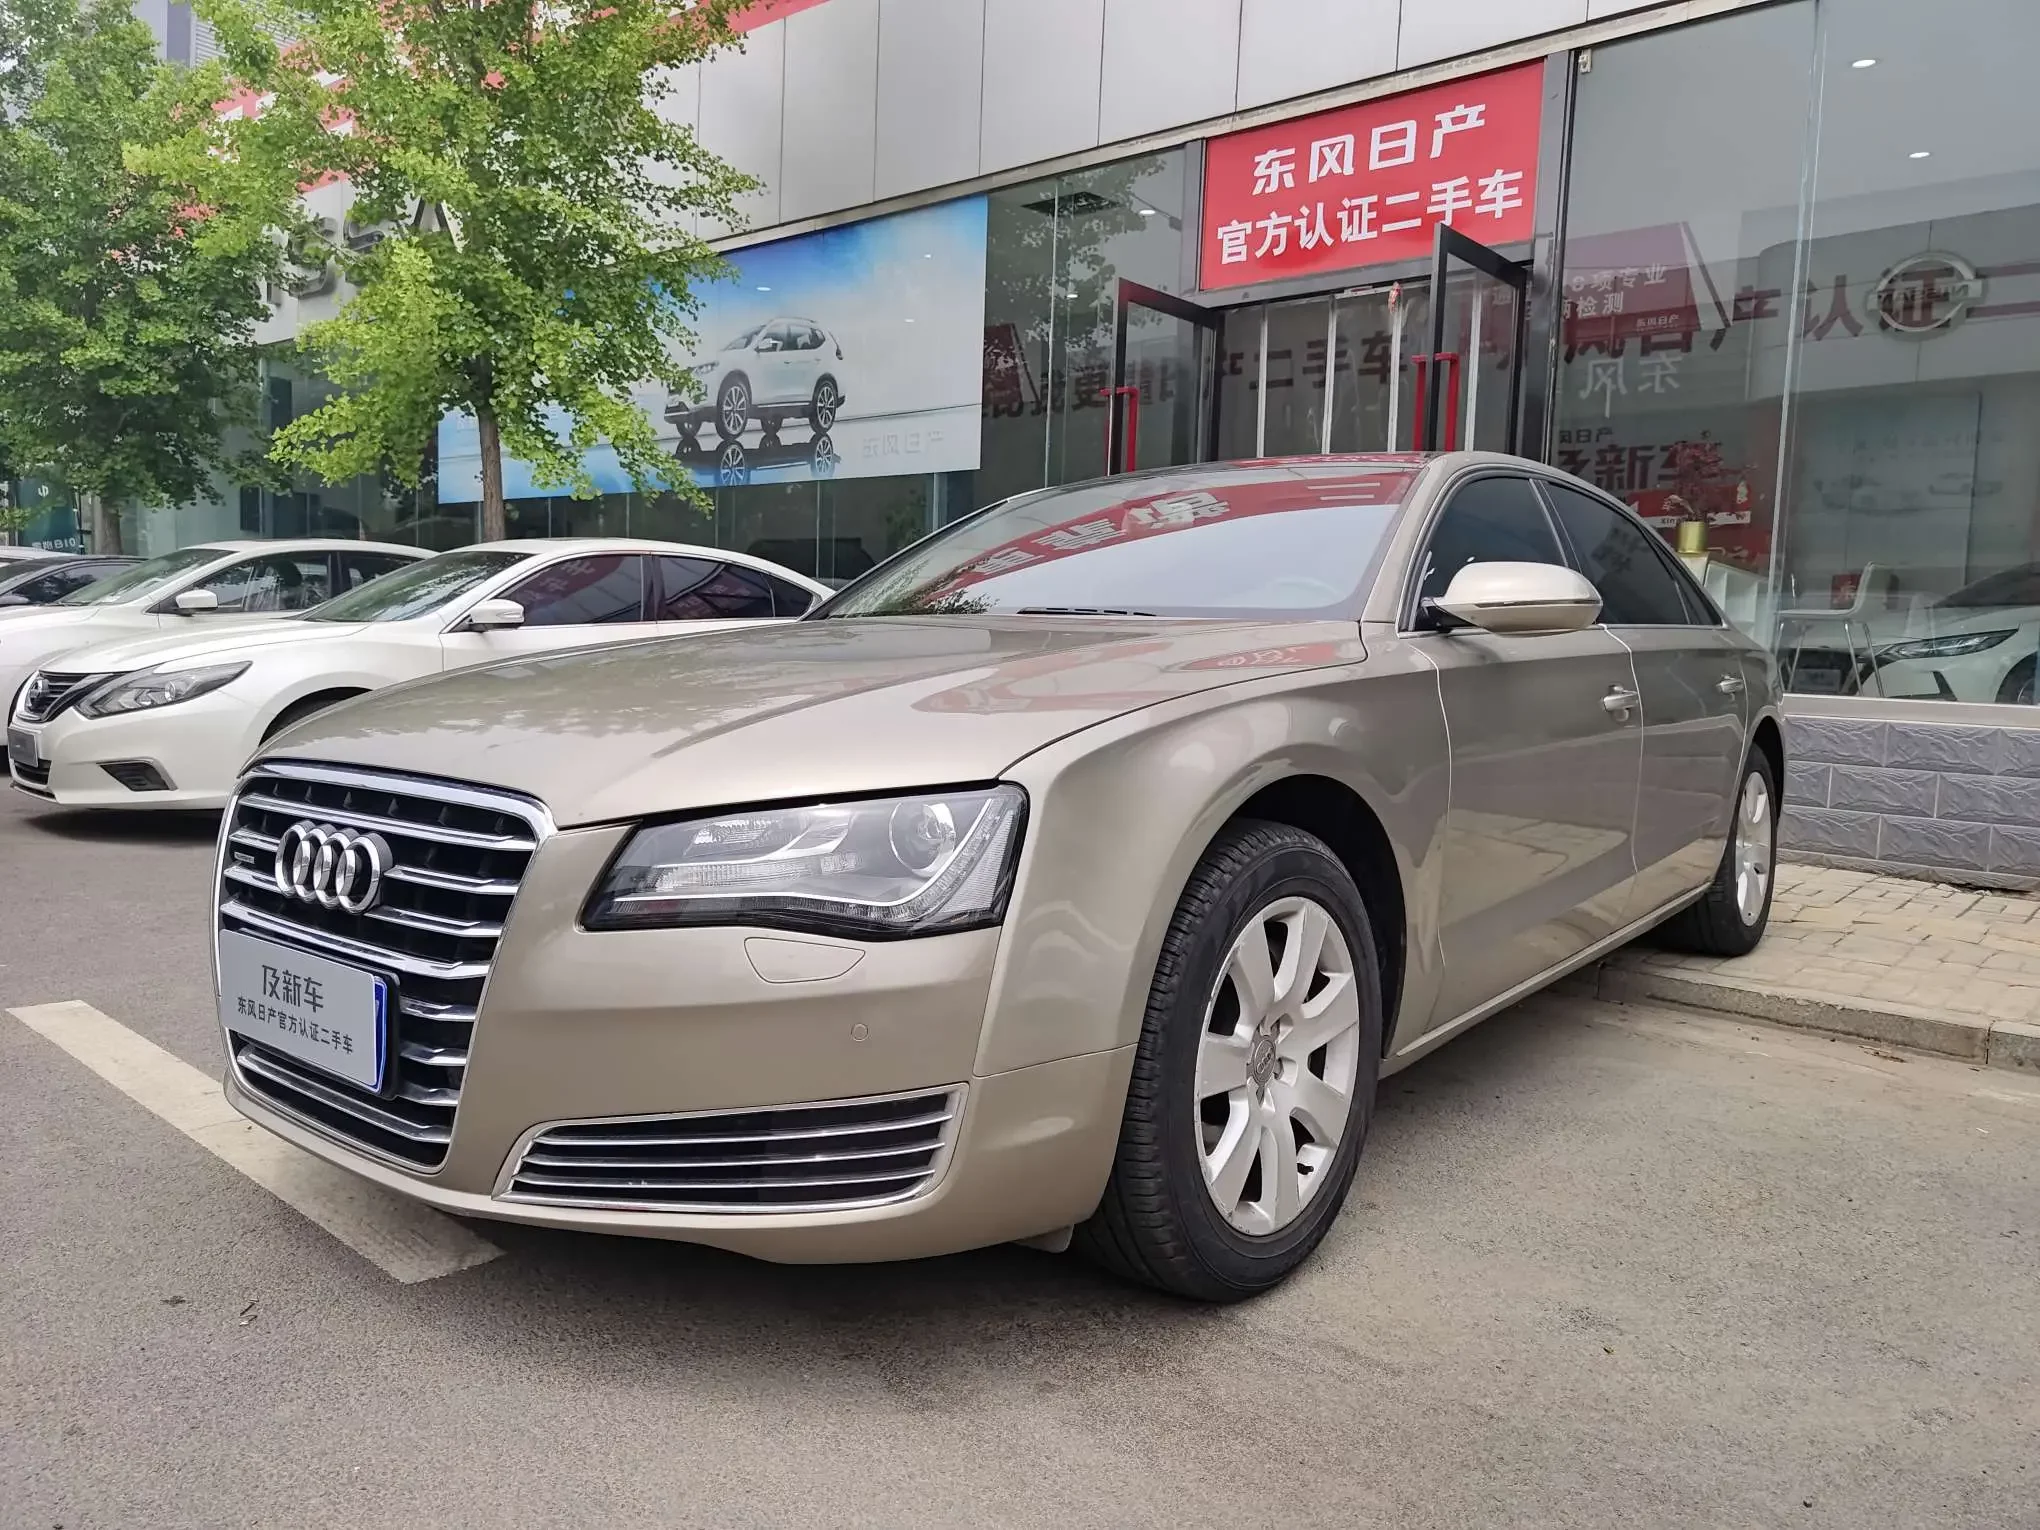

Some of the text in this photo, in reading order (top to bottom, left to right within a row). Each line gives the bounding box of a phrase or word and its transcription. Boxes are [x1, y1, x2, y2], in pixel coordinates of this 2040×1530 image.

[1251, 104, 1487, 196] 东风日产
[1217, 168, 1523, 265] 官方认证二手车
[237, 996, 354, 1055] 东风日产官方认证二手车
[261, 964, 324, 1013] 及新车
